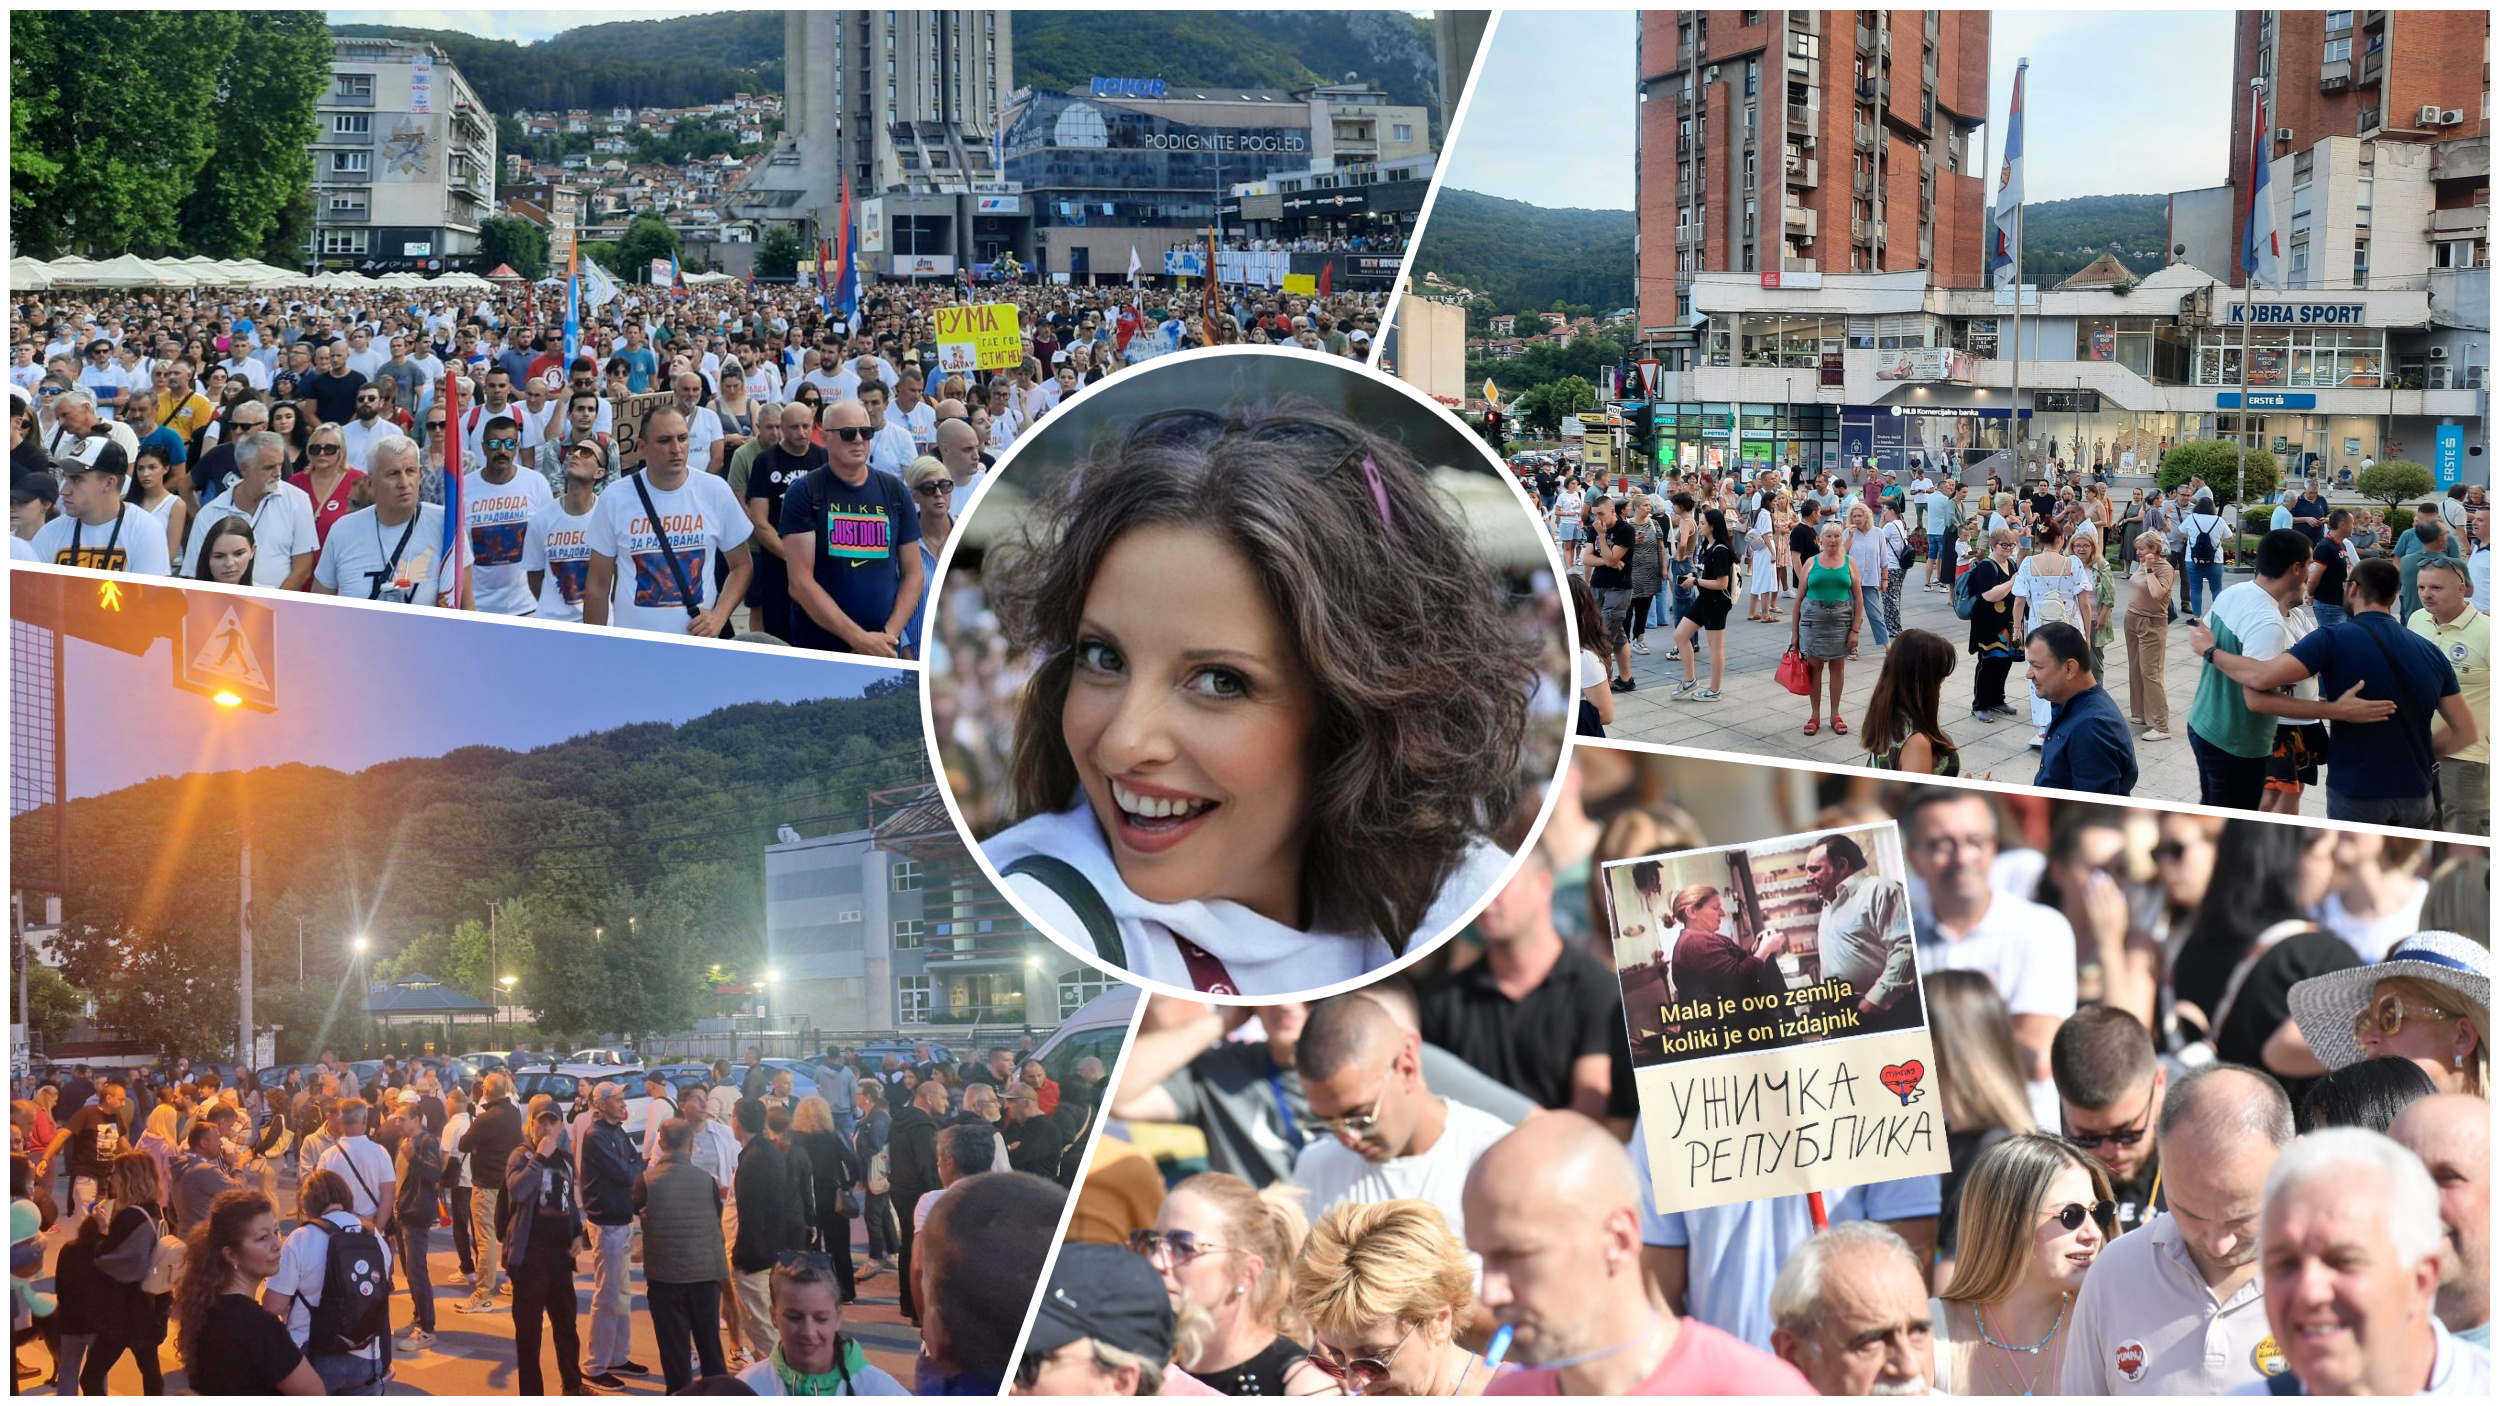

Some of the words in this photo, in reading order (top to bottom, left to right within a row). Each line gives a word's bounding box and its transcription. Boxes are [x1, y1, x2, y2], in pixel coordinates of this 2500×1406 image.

[1145, 134, 1234, 150] PODIGNITE
[1240, 135, 1305, 151] POGLED
[916, 258, 932, 267] dm
[936, 306, 999, 335] РУМА
[2300, 306, 2363, 323] SPORT
[2249, 396, 2275, 405] ERSTE
[1917, 408, 1957, 417] Komercijalna
[2443, 450, 2456, 481] ERSTE
[472, 496, 528, 513] СЛОБОДА
[830, 503, 885, 514] NIKE
[484, 511, 527, 523] РАДОВАНА!
[630, 513, 704, 534] СЛБОДА
[831, 519, 859, 545] JUST
[860, 520, 876, 546] DO
[630, 538, 643, 549] ЗА
[646, 534, 704, 548] РАОВАНА!
[1660, 1002, 1712, 1024] Mala
[1716, 998, 1736, 1020] je
[1742, 995, 1778, 1013] ovo
[1784, 979, 1853, 1007] zemlja
[1661, 1026, 1718, 1055] koliki
[1722, 1029, 1743, 1051] je
[1747, 1025, 1774, 1042] on
[1779, 1007, 1860, 1039] izdajnik
[1670, 1062, 1860, 1139] УЖИЧКА
[1685, 1111, 1932, 1188] РЕПУБЛИКА
[2116, 1349, 2143, 1362] PUMPAJ
